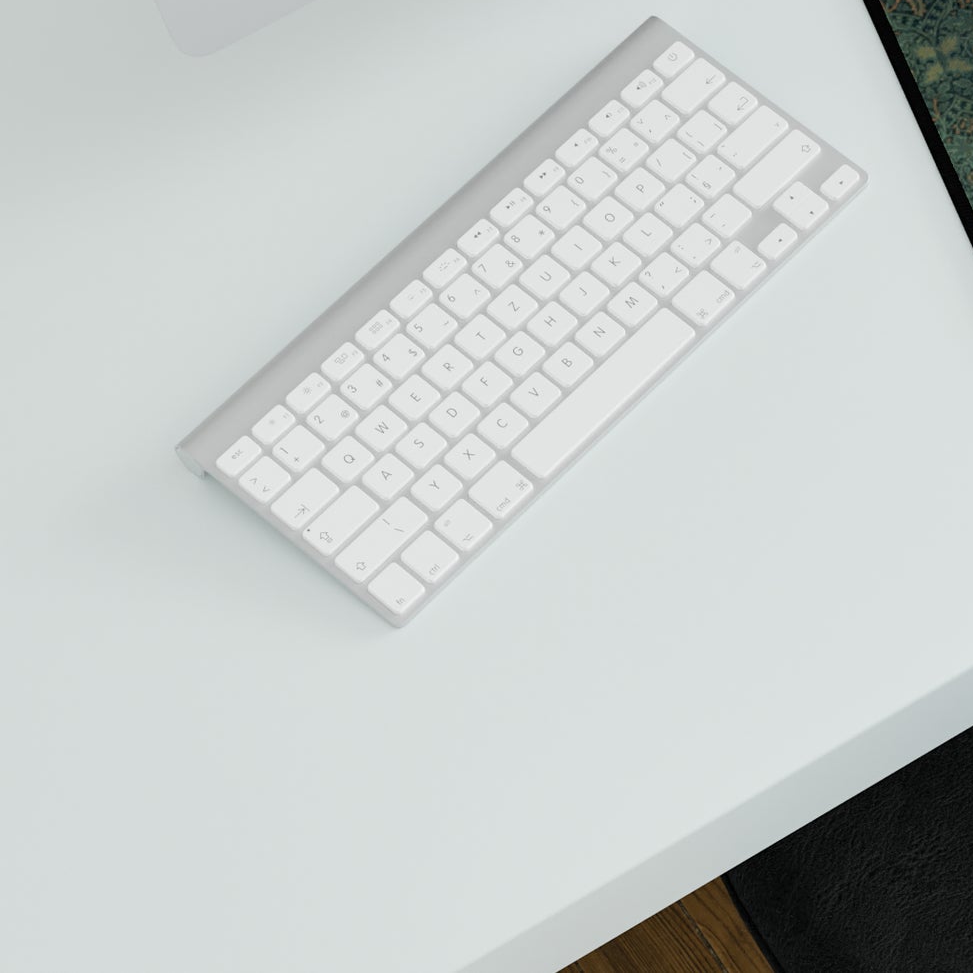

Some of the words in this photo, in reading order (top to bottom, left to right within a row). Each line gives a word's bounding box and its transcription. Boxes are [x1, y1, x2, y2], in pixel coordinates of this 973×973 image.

[279, 446, 289, 455] 1
[313, 414, 325, 425] 2
[346, 384, 358, 394] 3
[381, 353, 391, 362] 4
[413, 323, 424, 333] 5
[446, 293, 456, 303] 6
[477, 263, 487, 273] 7
[510, 234, 521, 244] 8
[542, 205, 552, 214] 9
[574, 176, 585, 187] 0
[343, 454, 356, 465] Q
[374, 420, 390, 435] W
[409, 391, 422, 403] E
[442, 362, 455, 372] R
[475, 330, 486, 340] T
[507, 300, 521, 313] Z
[538, 270, 553, 282] U
[573, 243, 584, 251] I
[604, 212, 616, 223] O
[635, 183, 645, 194] P
[380, 470, 393, 481] A
[413, 438, 425, 449] S
[445, 407, 458, 419] D
[479, 376, 489, 387] F
[512, 346, 524, 357] G
[543, 315, 557, 328] H
[578, 286, 588, 297] J
[607, 256, 621, 267] K
[640, 229, 653, 237] L
[428, 479, 440, 490] Y
[462, 448, 476, 461] X
[496, 418, 509, 429] C
[527, 387, 540, 397] V
[560, 357, 573, 368] B
[592, 326, 607, 339] N
[624, 296, 640, 309] M
[495, 497, 511, 512] cmd
[716, 289, 731, 305] cmd
